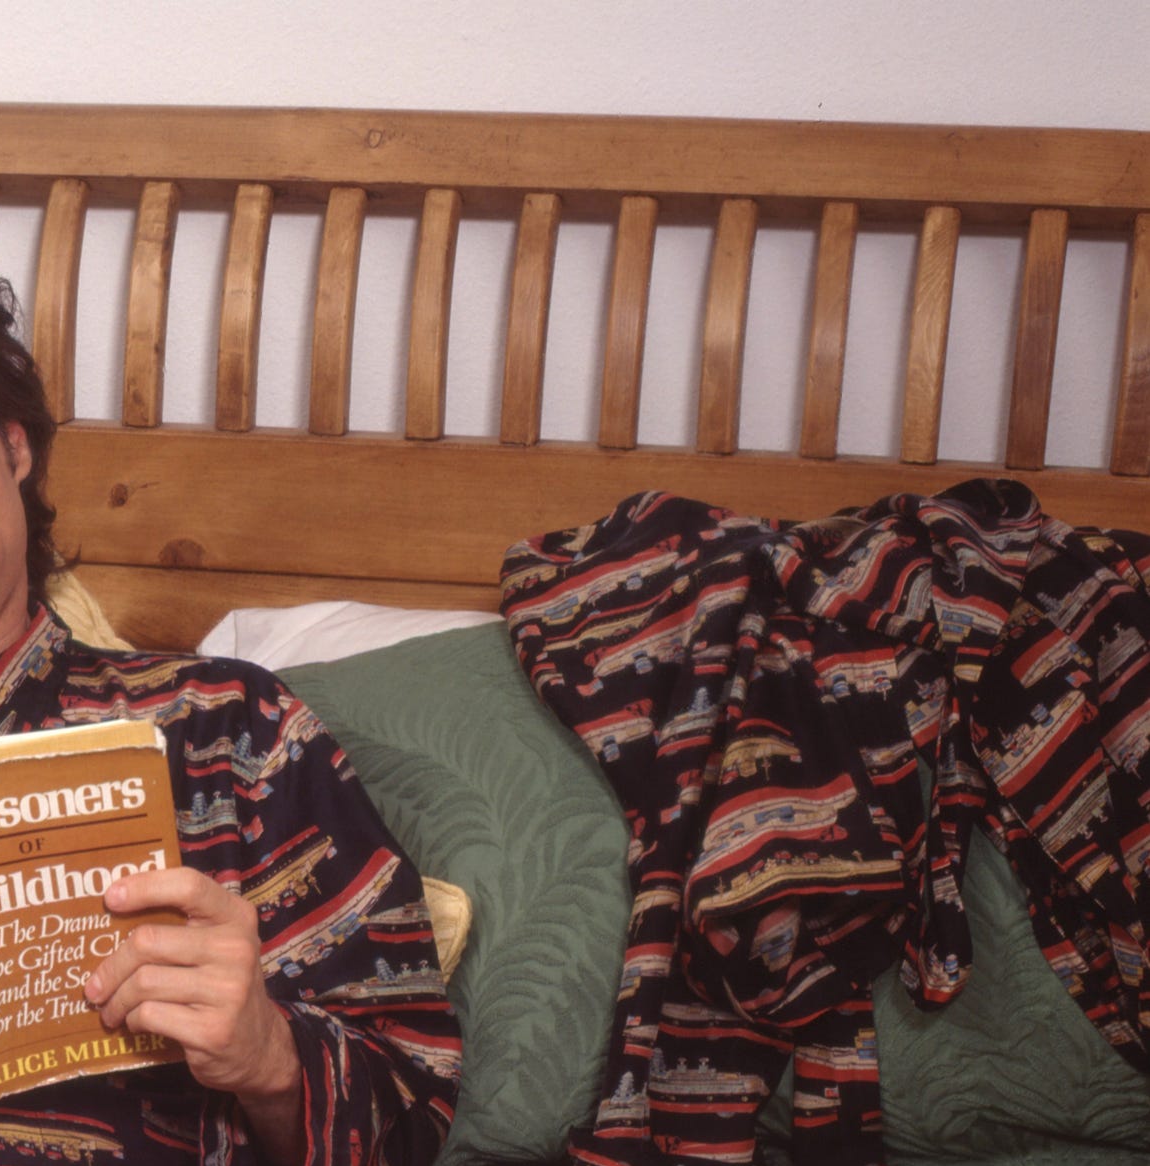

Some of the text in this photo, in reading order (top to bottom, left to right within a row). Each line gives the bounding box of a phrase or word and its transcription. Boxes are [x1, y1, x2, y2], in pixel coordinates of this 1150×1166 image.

[19, 838, 46, 854] OF
[39, 913, 111, 939] Drama
[18, 937, 85, 972] Gifted
[34, 969, 62, 996] the
[16, 1002, 44, 1028] the
[63, 1033, 166, 1065] MILLER
